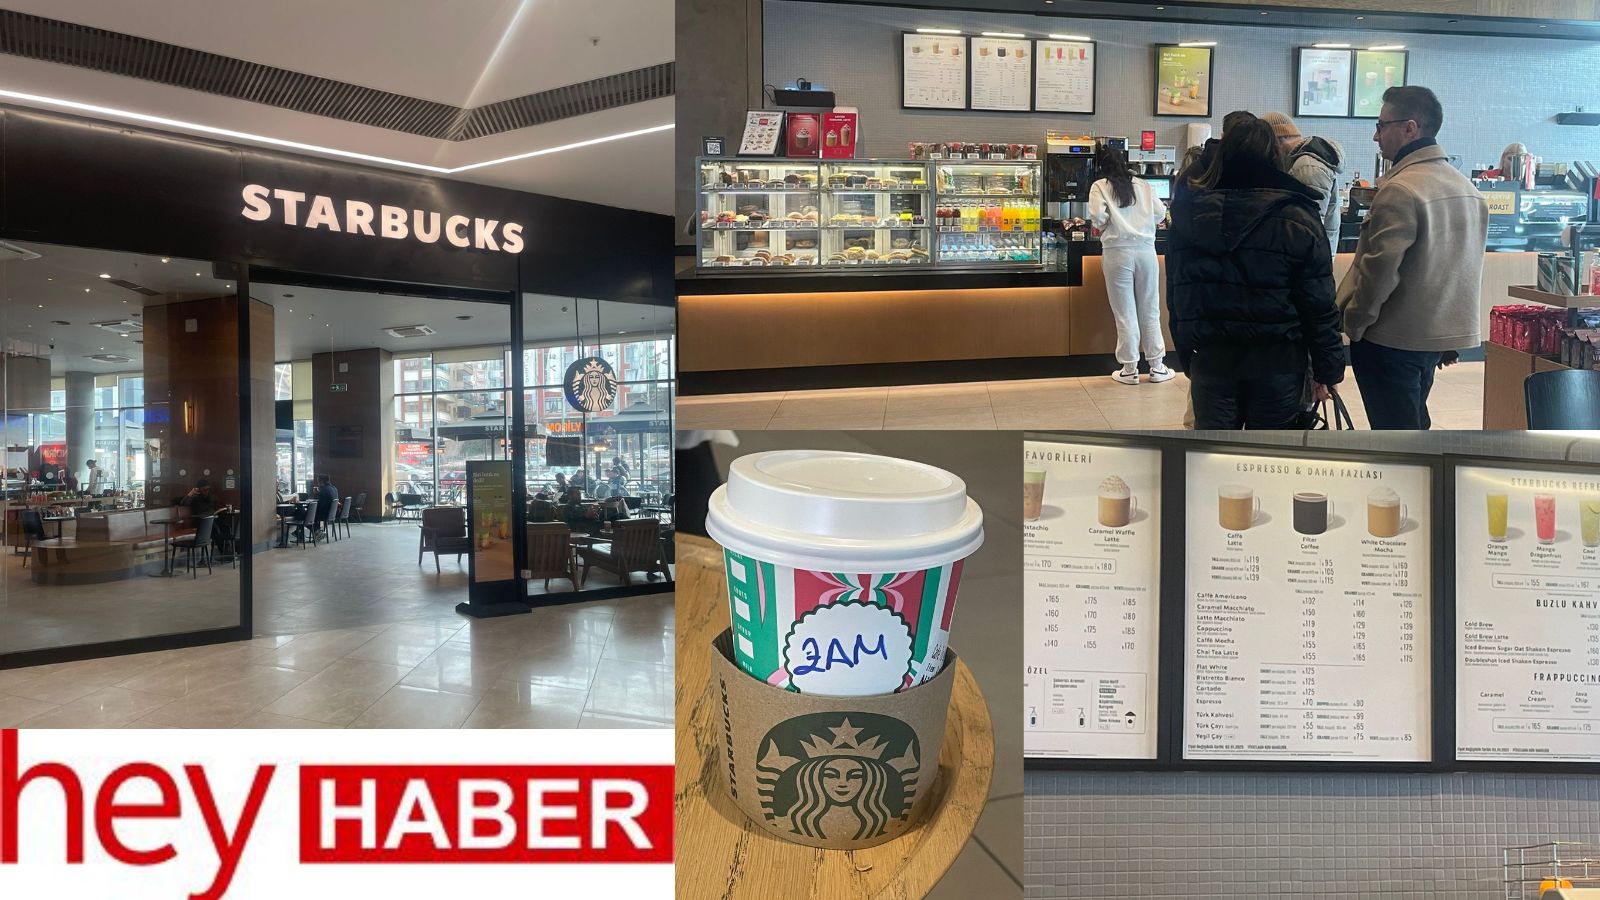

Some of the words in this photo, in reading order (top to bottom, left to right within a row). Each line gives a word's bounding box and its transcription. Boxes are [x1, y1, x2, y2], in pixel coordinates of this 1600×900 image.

[241, 183, 526, 256] STARBUCKS
[1025, 450, 1092, 463] FAVORİLERİ
[1236, 463, 1290, 474] ESPRESSO
[1307, 467, 1335, 477] DAHA
[1341, 468, 1382, 480] FAZLASI
[1511, 477, 1567, 488] STARBUCKS
[1536, 599, 1567, 608] BUZLU
[1572, 600, 1598, 609] KAHV
[1027, 666, 1048, 675] ÖZEL
[720, 677, 738, 800] STARBUCKS
